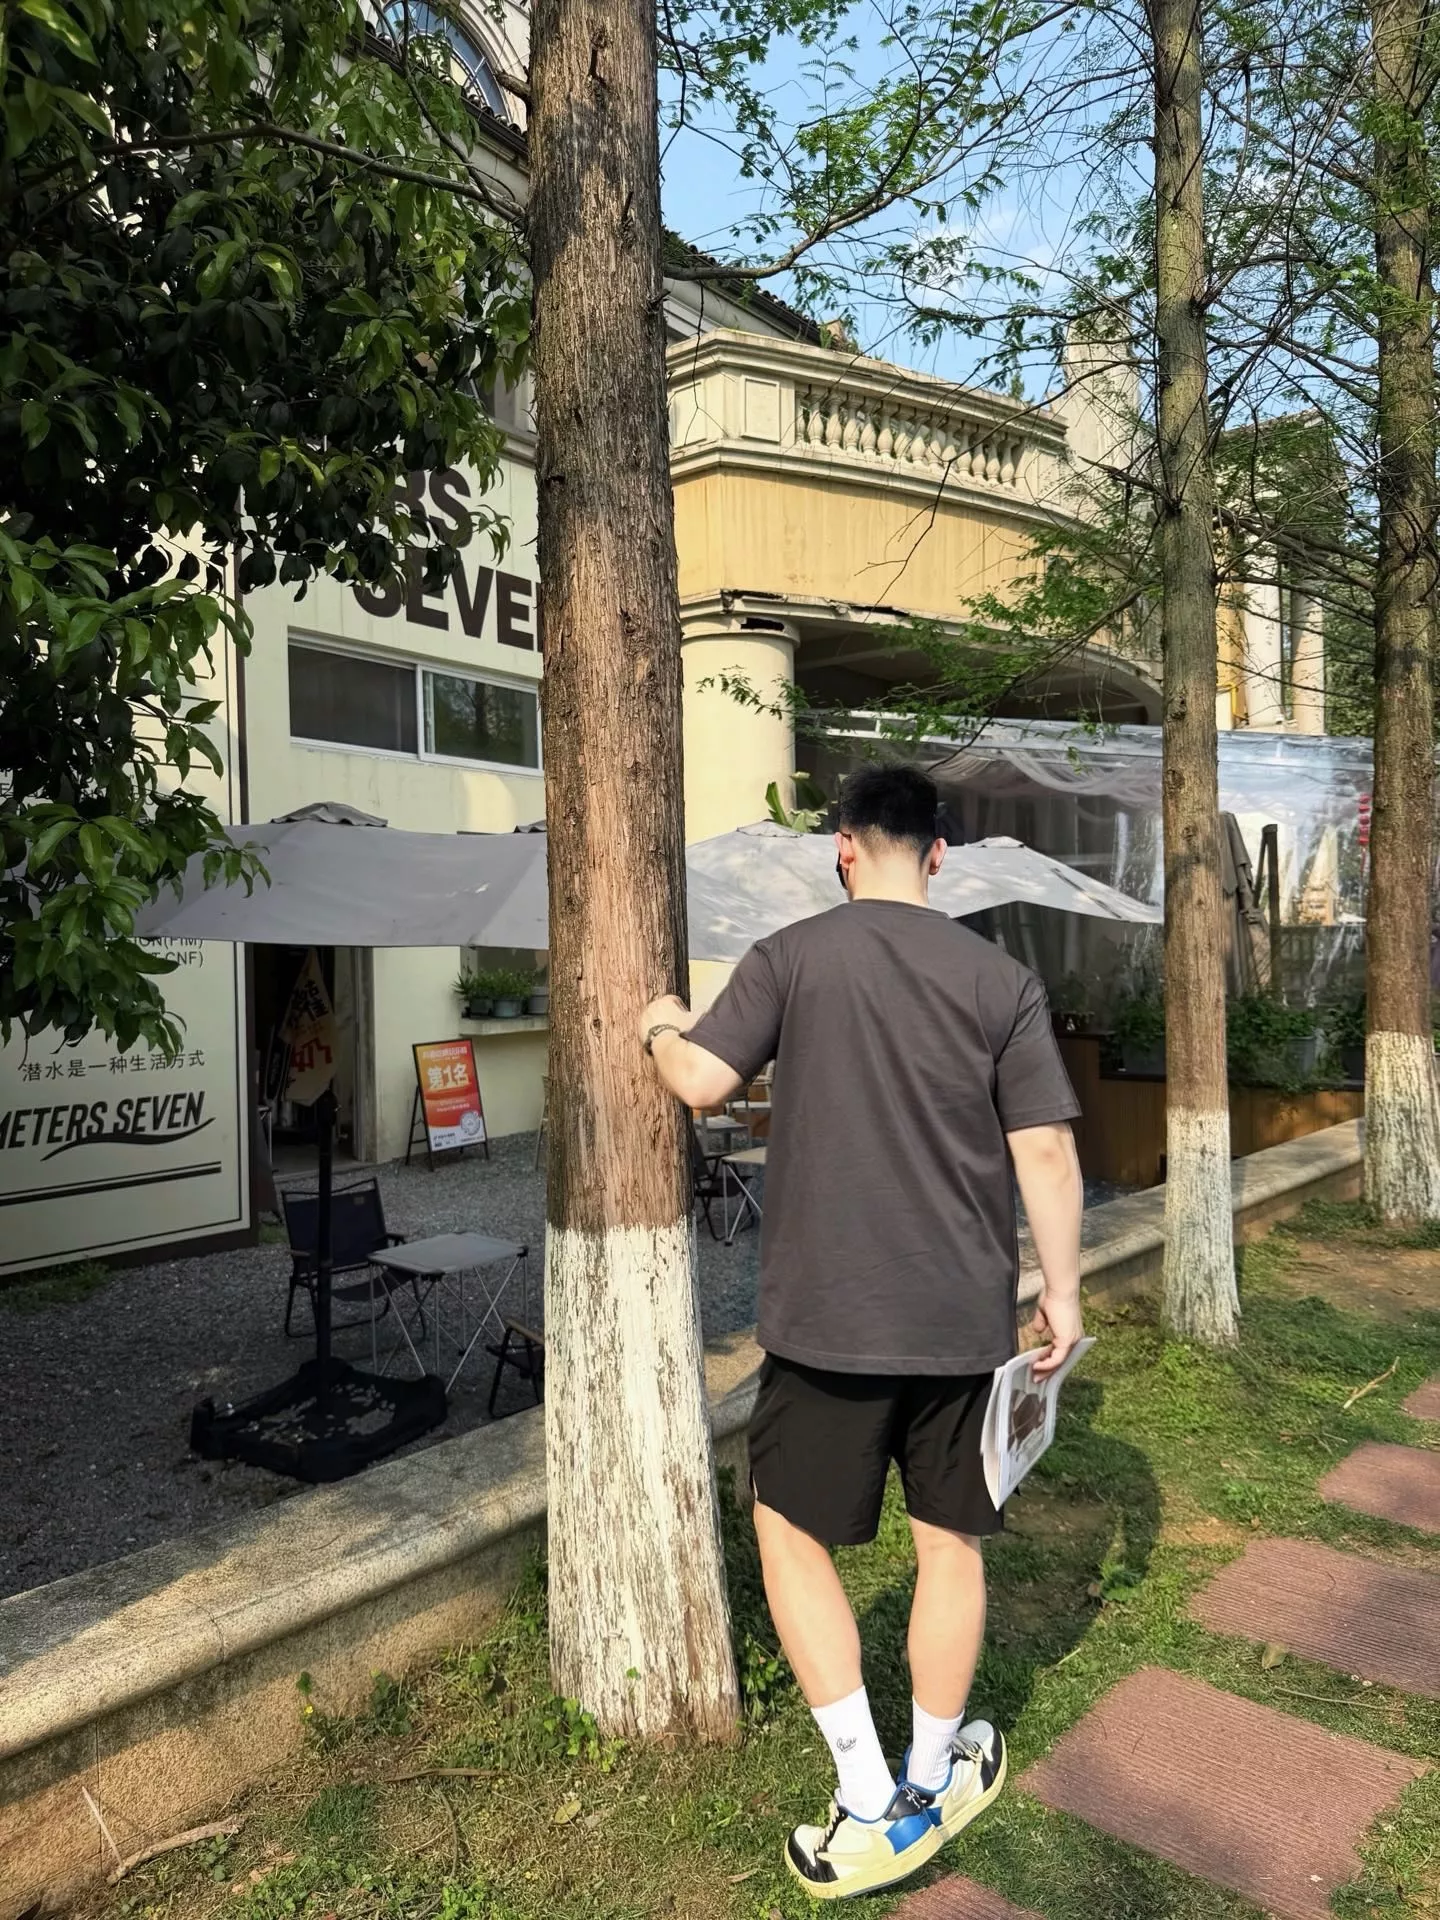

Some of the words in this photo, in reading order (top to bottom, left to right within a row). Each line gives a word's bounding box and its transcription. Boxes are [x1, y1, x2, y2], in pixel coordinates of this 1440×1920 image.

[22, 1050, 205, 1082] 潜水是一种生活方式
[428, 1062, 471, 1091] 第1名
[112, 1091, 205, 1136] SEVEN
